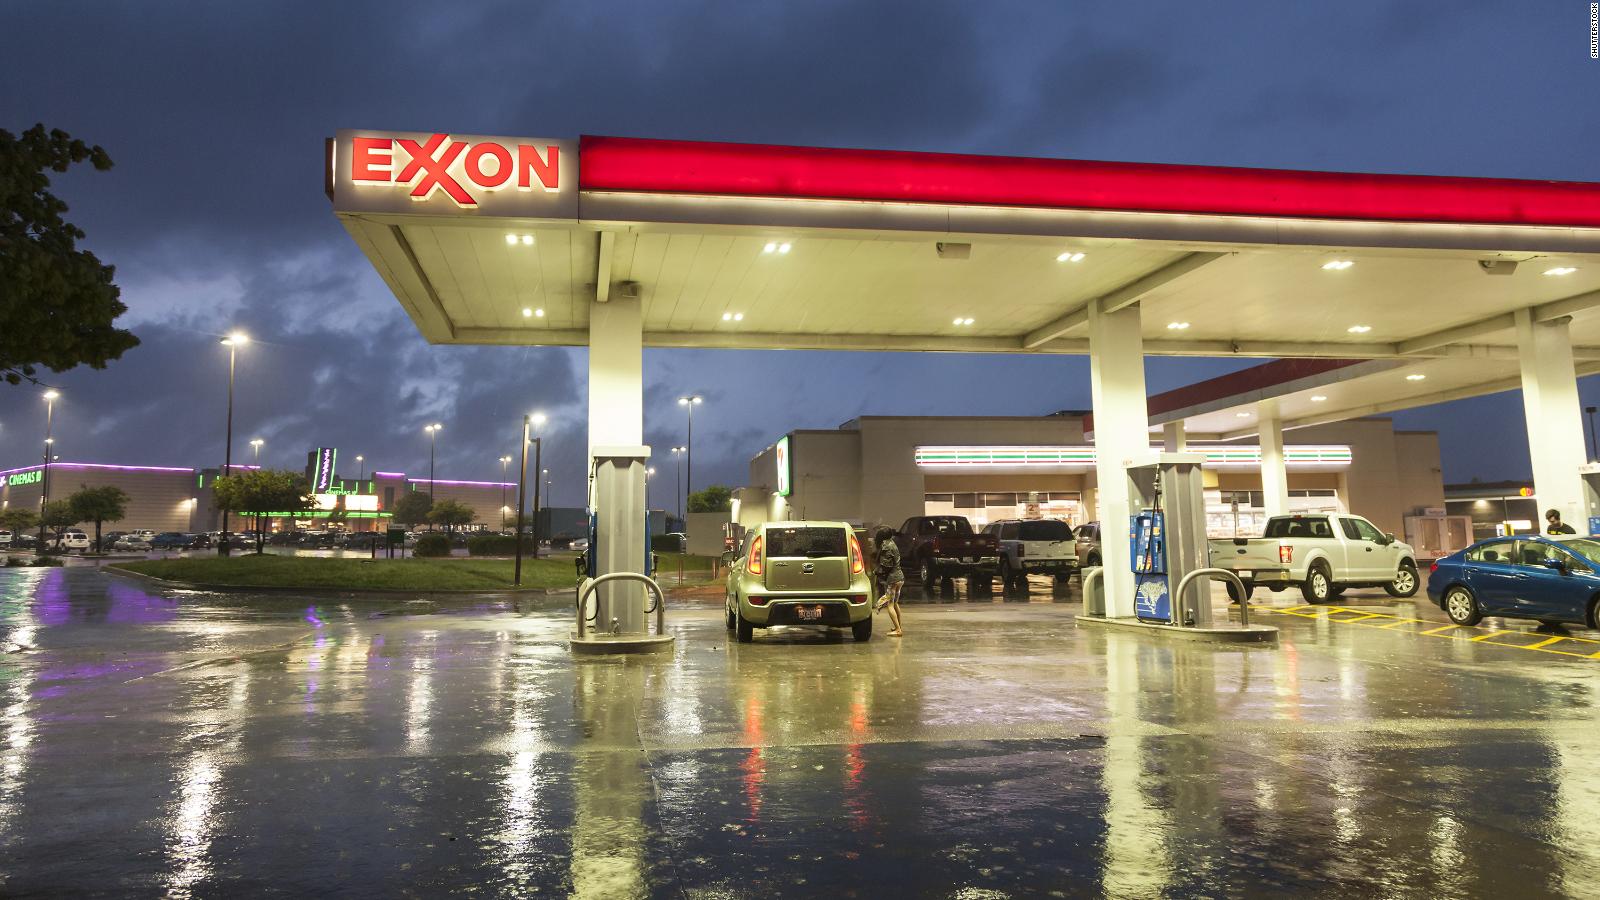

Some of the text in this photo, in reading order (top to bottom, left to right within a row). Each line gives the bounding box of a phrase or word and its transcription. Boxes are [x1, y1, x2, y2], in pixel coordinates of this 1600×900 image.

[352, 133, 559, 206] EXXON
[9, 471, 36, 486] CINEMAS
[36, 470, 42, 482] 10
